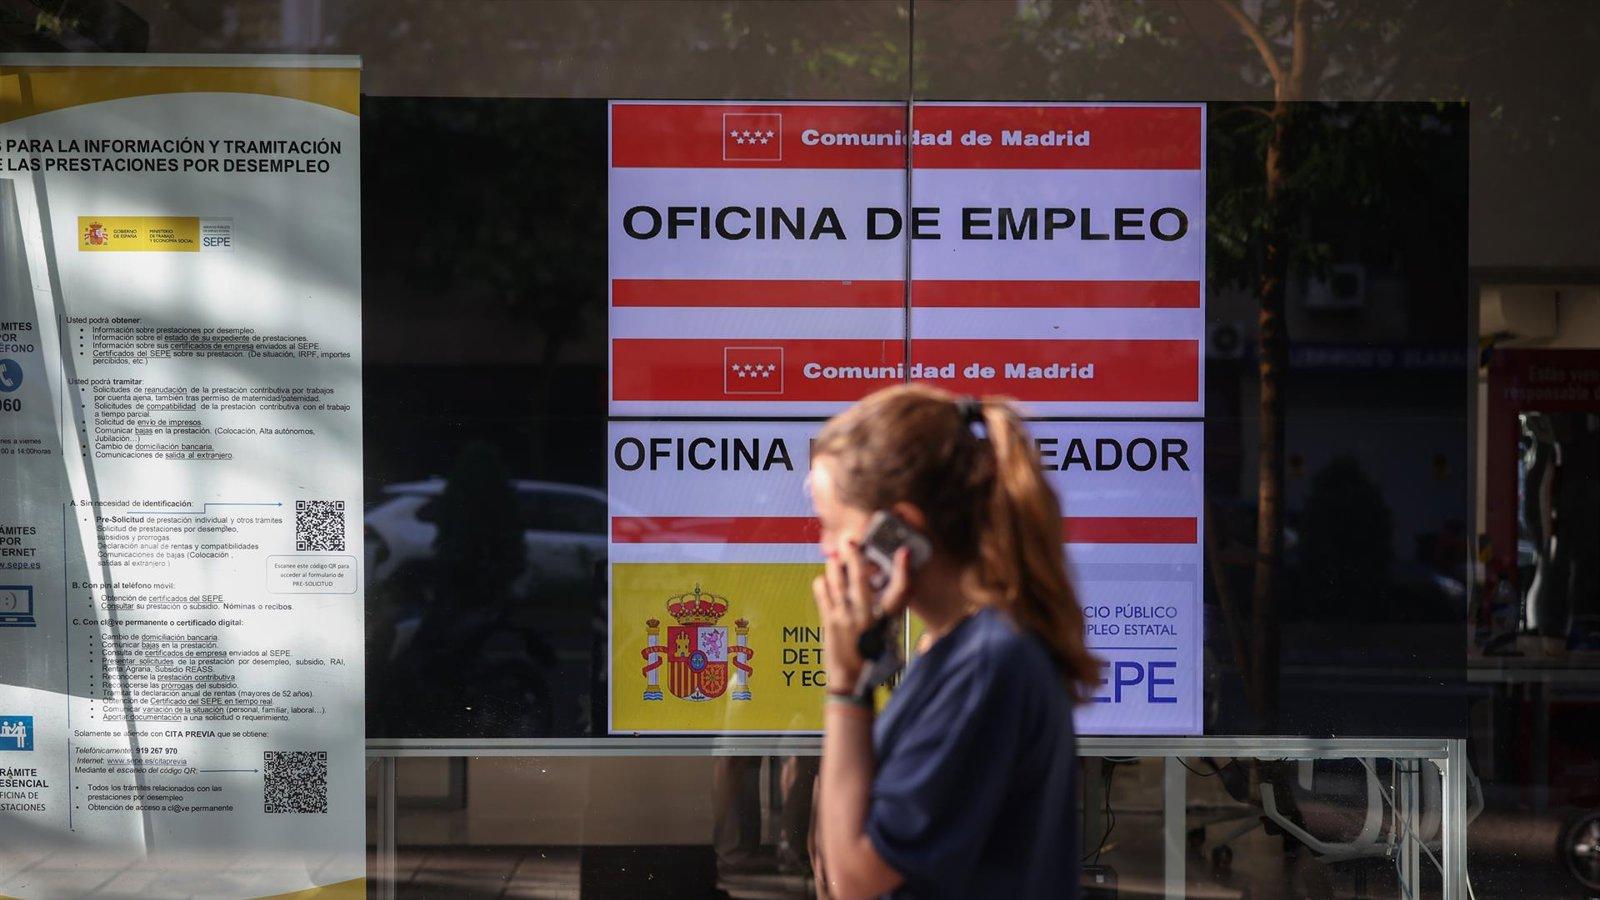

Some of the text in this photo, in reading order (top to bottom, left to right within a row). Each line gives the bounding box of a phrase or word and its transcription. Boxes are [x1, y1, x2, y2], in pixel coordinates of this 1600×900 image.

[801, 129, 1090, 147] Comunidad de Madrid
[6, 139, 54, 153] PARA
[58, 139, 80, 153] LA
[85, 136, 205, 153] INFORMACIÓN
[209, 140, 220, 154] Y
[223, 137, 341, 154] TRAMITACIÓN
[7, 158, 41, 172] LAS
[45, 158, 179, 172] PRESTACIONES
[184, 159, 219, 172] POR
[223, 159, 330, 173] DESEMPLEO
[622, 205, 1190, 241] OFICINA DE EMPLEO
[203, 237, 231, 247] SEPE
[803, 362, 1094, 379] Comunidad de Madrid
[90, 378, 111, 386] podrá
[614, 436, 794, 471] OFICINA
[156, 516, 193, 524] prestación
[0, 537, 21, 545] POR
[1115, 603, 1178, 619] PÚBLICO
[125, 619, 168, 627] permanente
[1083, 624, 1178, 635] PLEO ESTATAL
[783, 648, 809, 665] DE
[782, 670, 796, 686] Y
[28, 791, 39, 799] DE
[88, 794, 132, 802] prestaciones
[146, 794, 184, 802] desempleo
[1, 803, 46, 811] STACIONES
